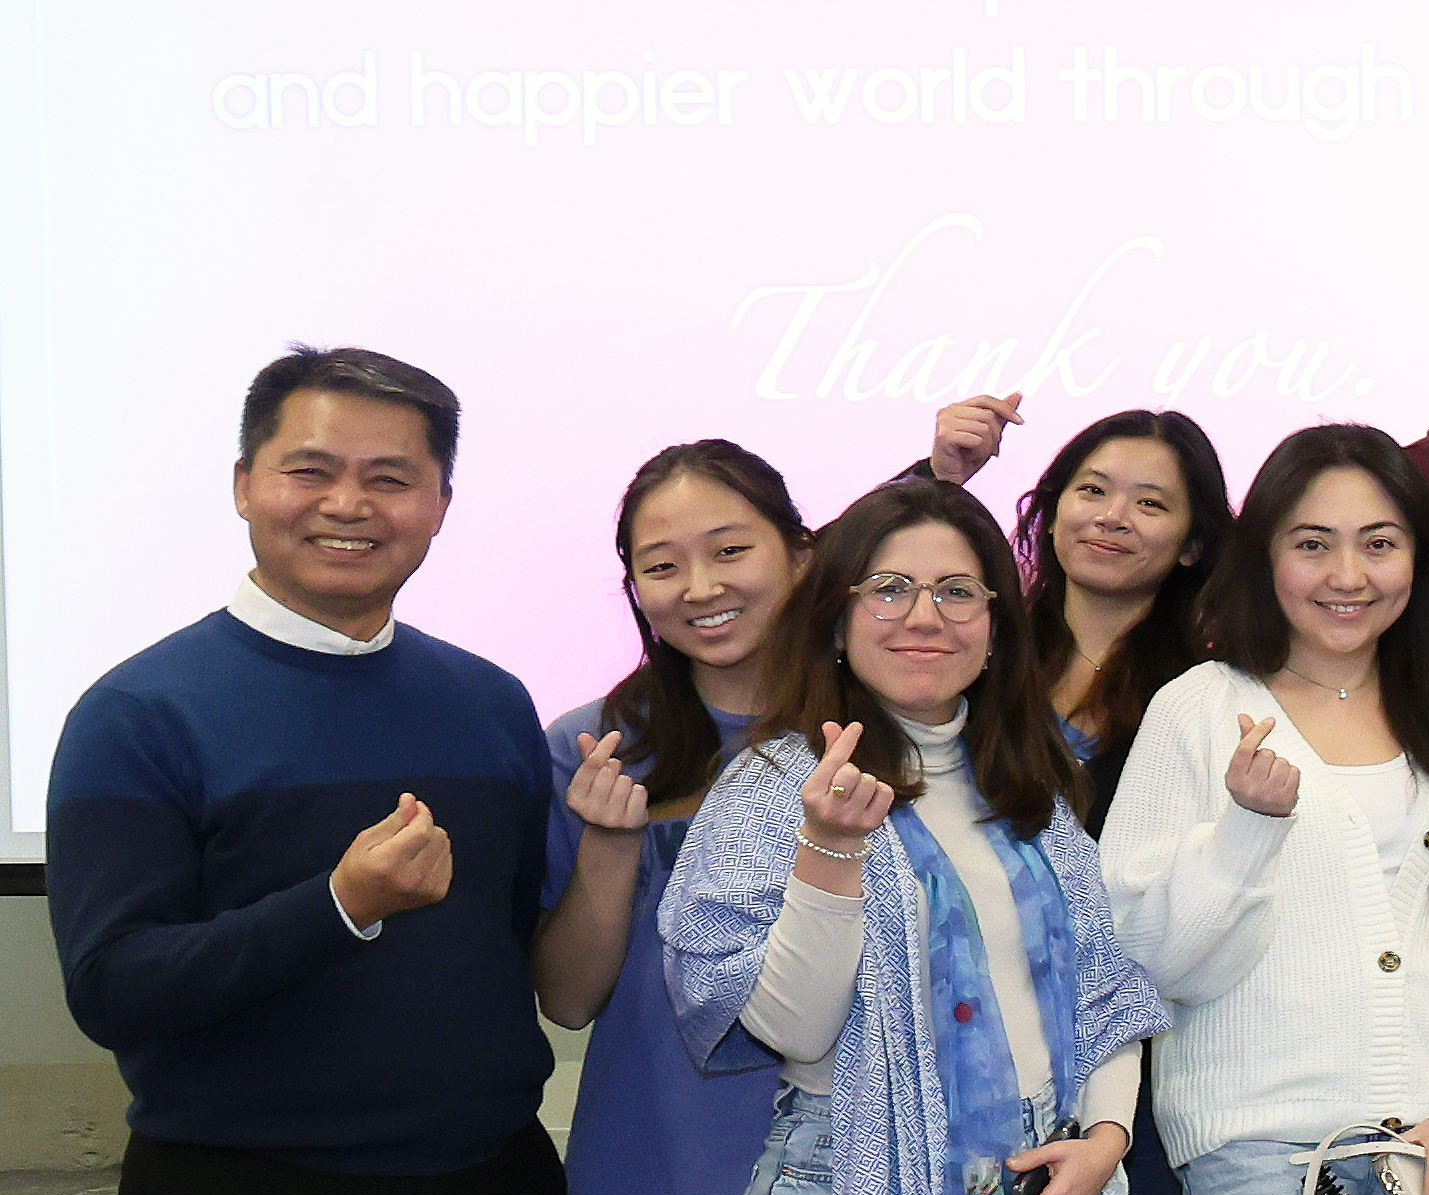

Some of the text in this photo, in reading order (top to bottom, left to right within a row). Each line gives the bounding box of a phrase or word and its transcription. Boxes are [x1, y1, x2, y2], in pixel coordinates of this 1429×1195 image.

[212, 51, 379, 129] and
[410, 50, 750, 147] happier
[784, 46, 1027, 124] world
[1059, 44, 1415, 142] through
[731, 212, 1376, 410] Thank you.
